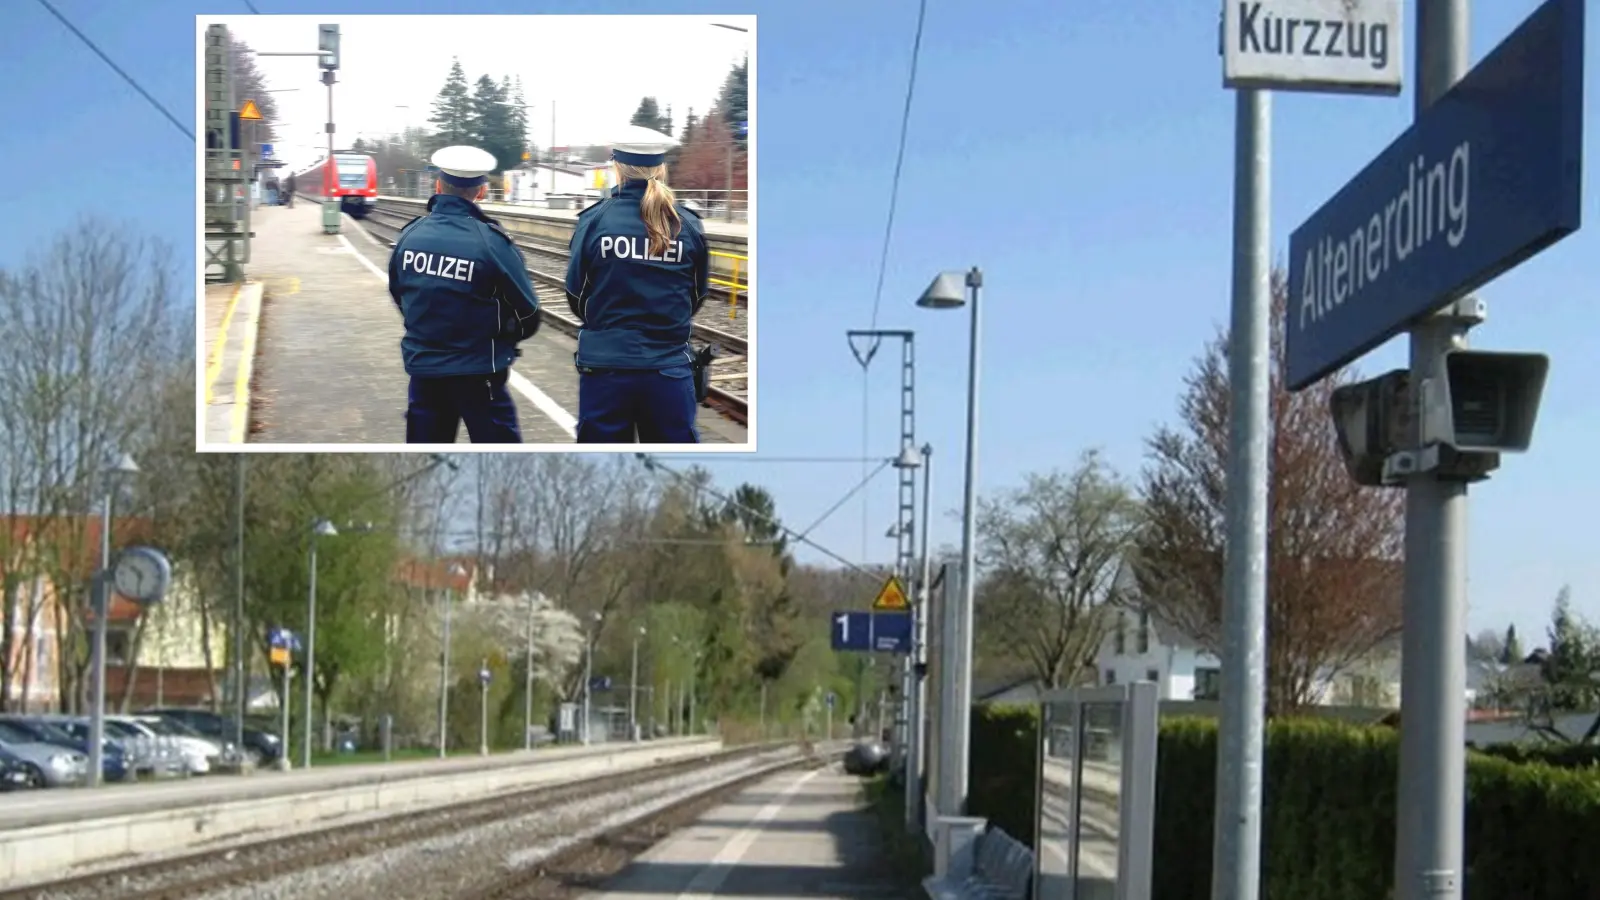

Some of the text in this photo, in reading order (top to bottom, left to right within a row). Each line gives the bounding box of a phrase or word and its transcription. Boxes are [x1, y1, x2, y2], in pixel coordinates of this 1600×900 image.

[1239, 2, 1388, 70] Kurzzug
[1300, 140, 1470, 331] Altenerding
[402, 250, 475, 282] POLIZEI
[836, 613, 849, 643] 1
